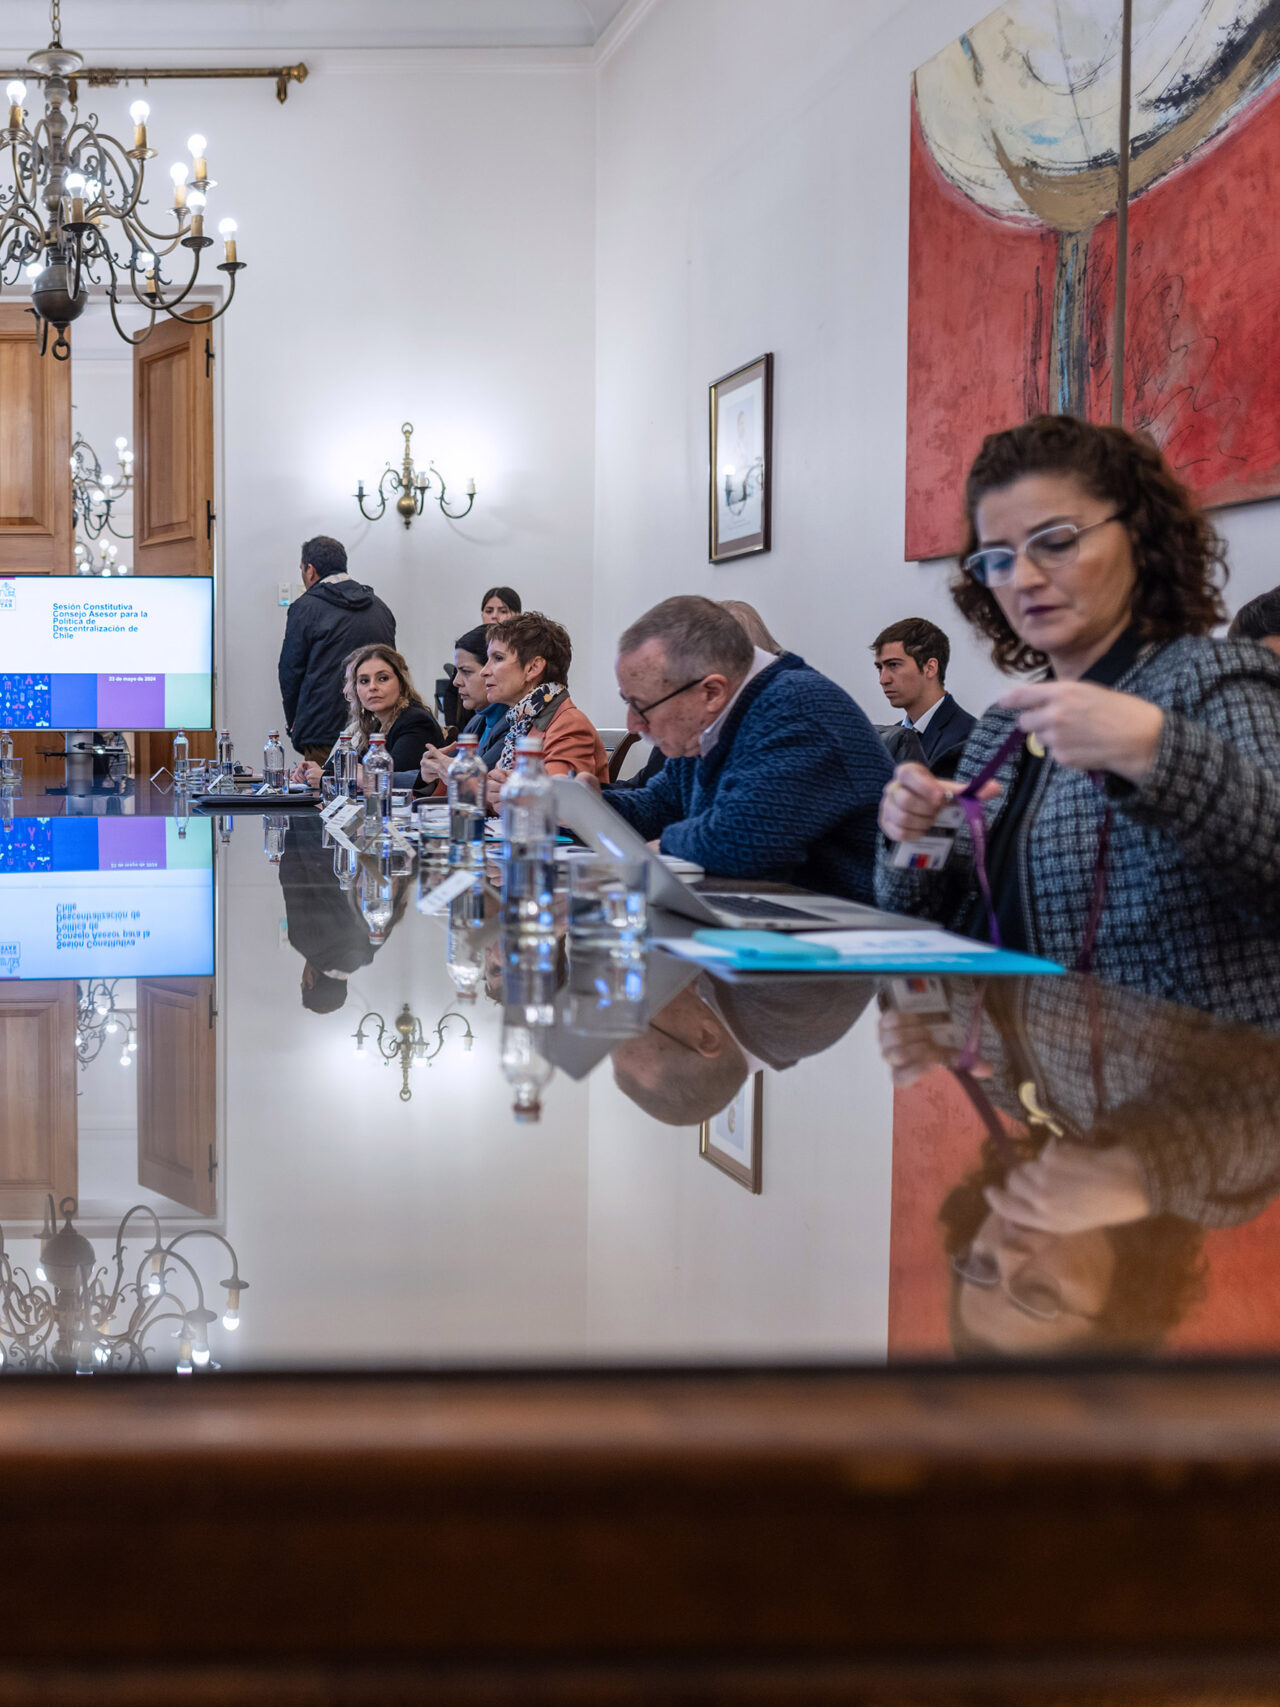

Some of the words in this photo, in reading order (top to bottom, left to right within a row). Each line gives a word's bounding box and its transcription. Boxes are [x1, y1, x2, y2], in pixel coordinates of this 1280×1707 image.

[52, 602, 81, 610] Sesión
[83, 602, 133, 610] Constitutiva
[52, 610, 87, 619] Consejo
[89, 610, 117, 618] Asesor
[140, 610, 148, 618] la
[85, 617, 96, 625] de
[52, 624, 126, 632] Descentralización
[52, 632, 74, 640] Chile
